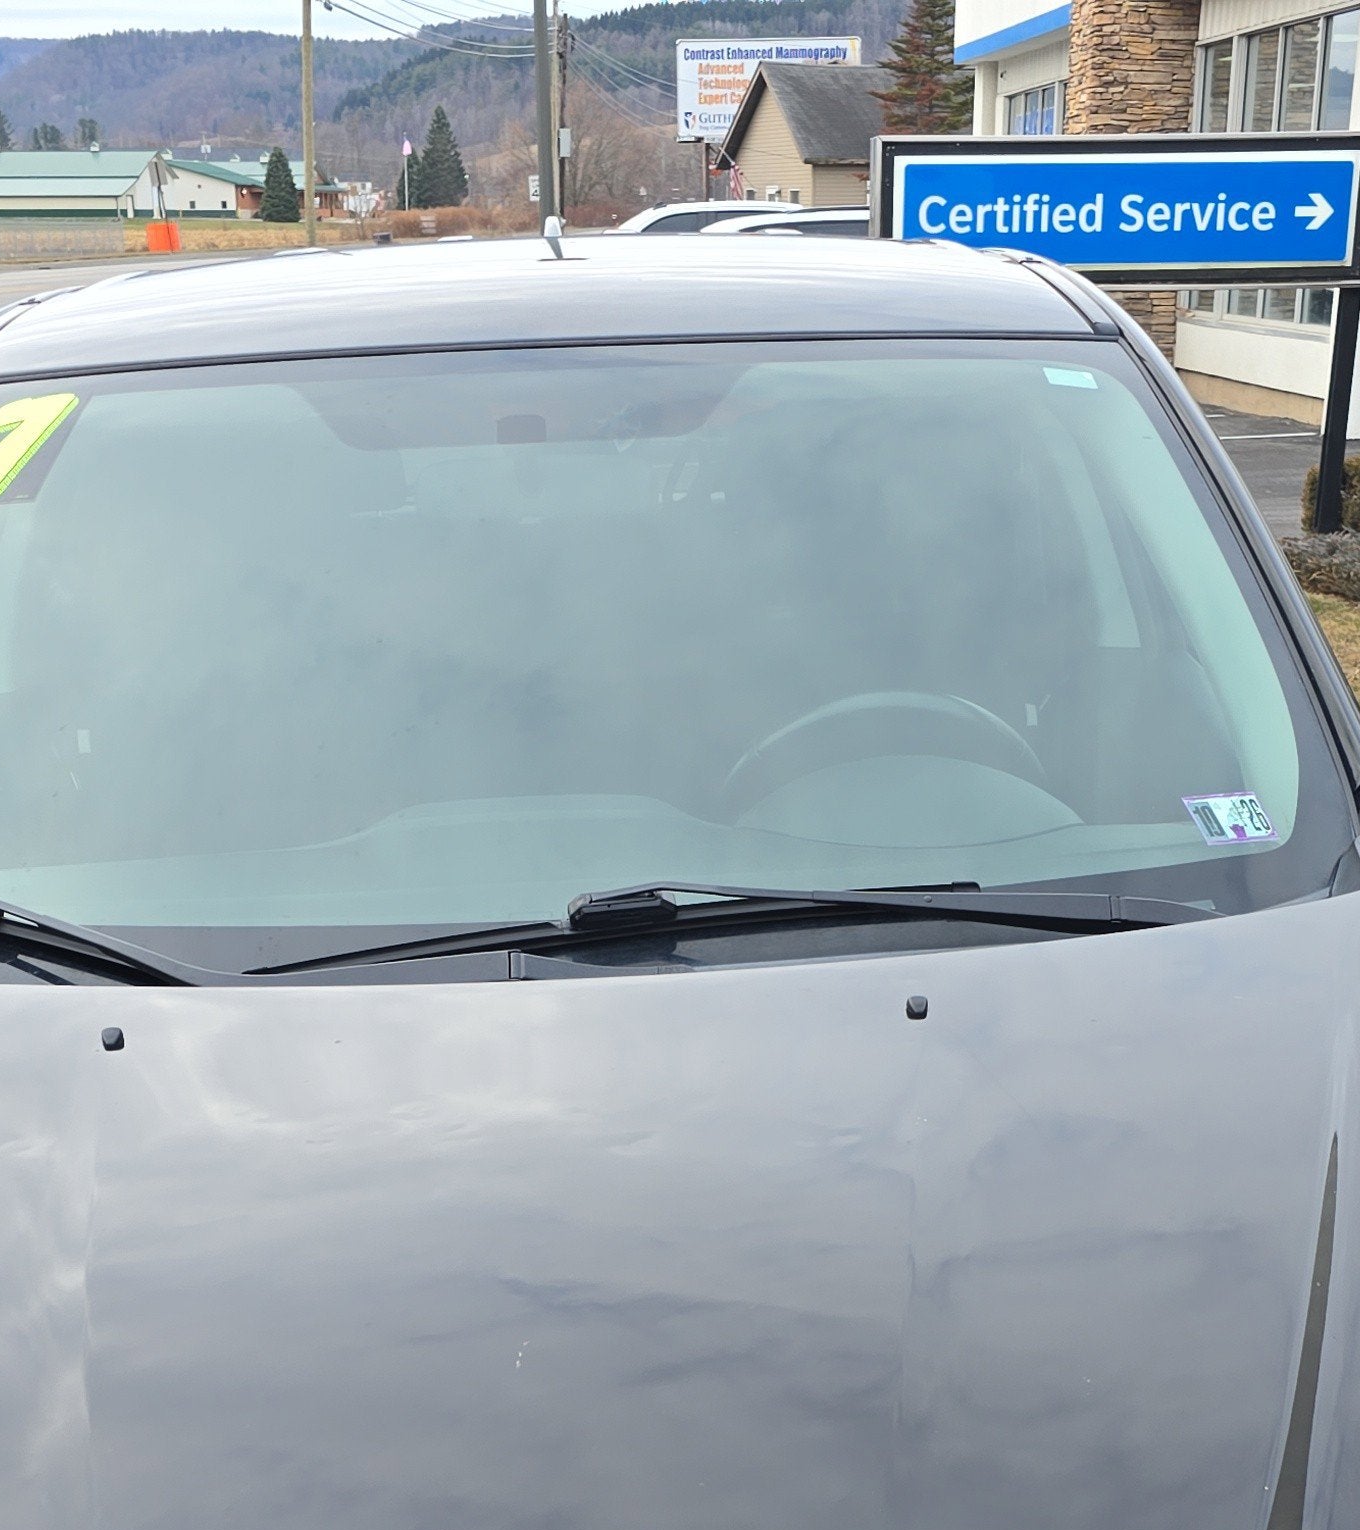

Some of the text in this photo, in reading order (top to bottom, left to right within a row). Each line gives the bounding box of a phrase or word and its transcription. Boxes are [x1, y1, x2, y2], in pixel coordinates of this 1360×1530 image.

[683, 45, 847, 61] Contrast Enhanced Mammography
[698, 62, 744, 75] Advanced
[698, 77, 750, 90] Technolog
[698, 92, 743, 105] Expert Ca
[699, 112, 734, 124] GUTH
[918, 193, 1277, 235] Certified Service
